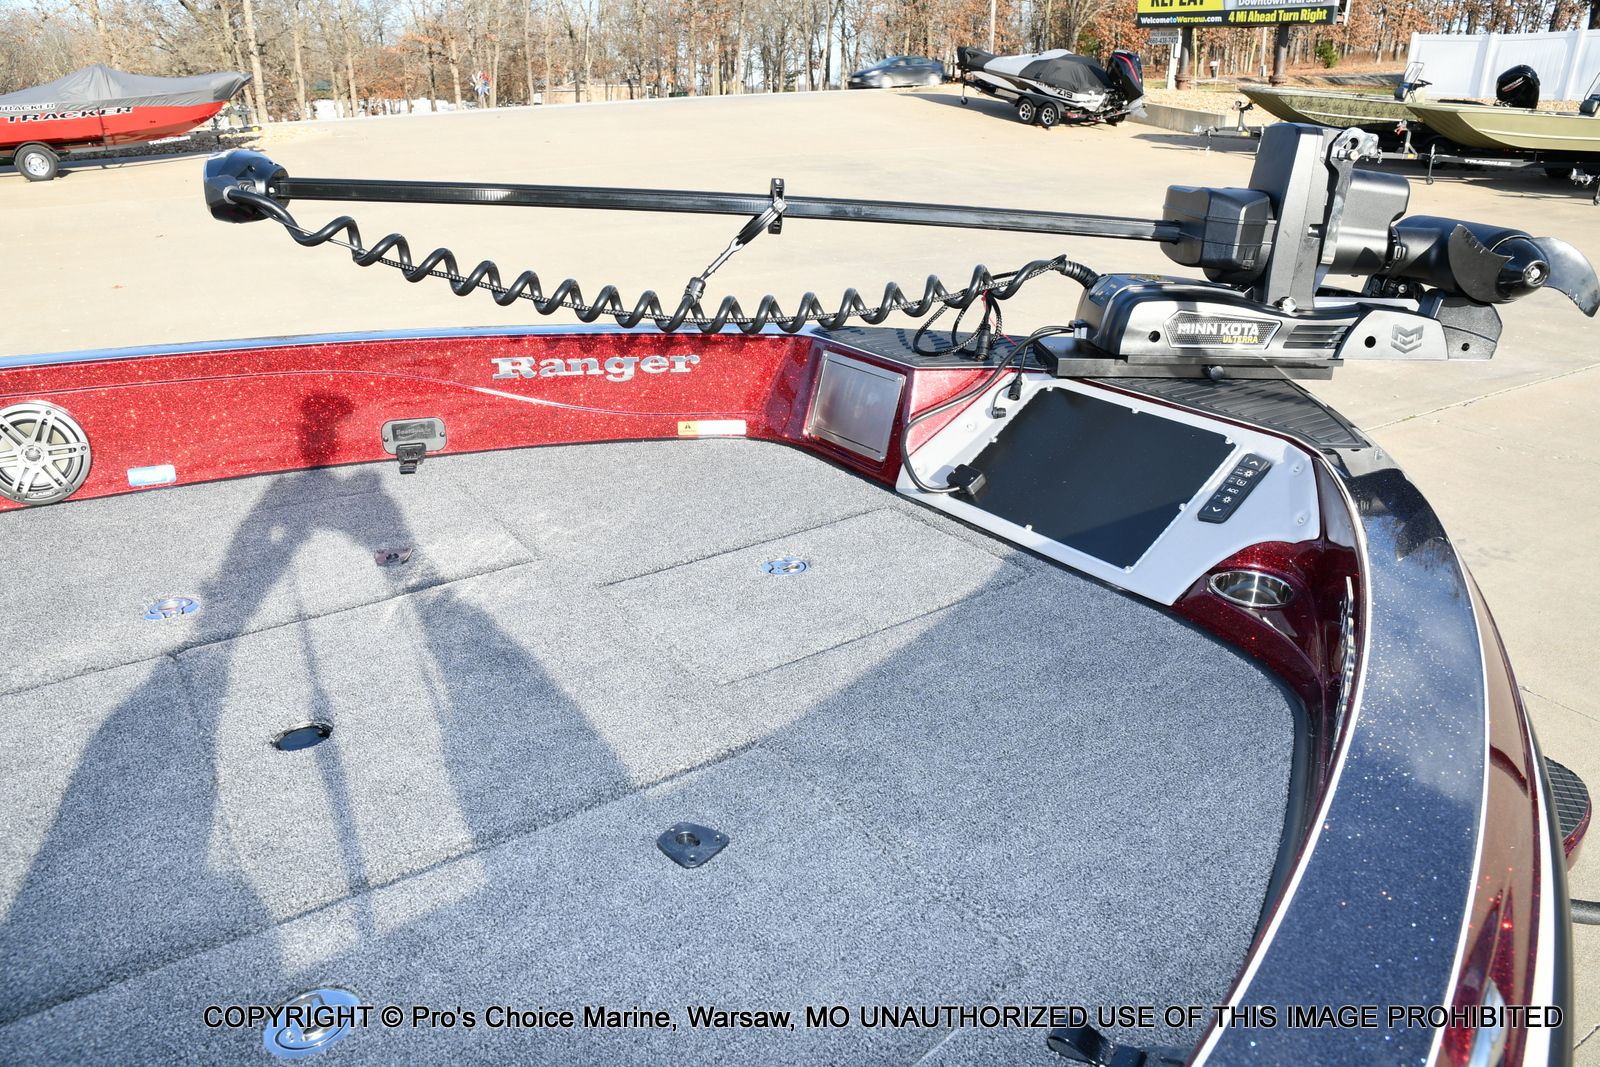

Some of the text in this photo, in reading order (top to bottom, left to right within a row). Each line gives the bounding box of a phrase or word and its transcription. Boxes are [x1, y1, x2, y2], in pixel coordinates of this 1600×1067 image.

[1140, 16, 1222, 24] WelcometoWarsaw.com
[1228, 8, 1327, 23] 4 Mi Ahead Turn Right
[8, 107, 133, 123] TRACKER
[1177, 322, 1260, 336] MINN KOTA
[1222, 336, 1258, 344] ULTERRA
[491, 354, 701, 383] Ranger
